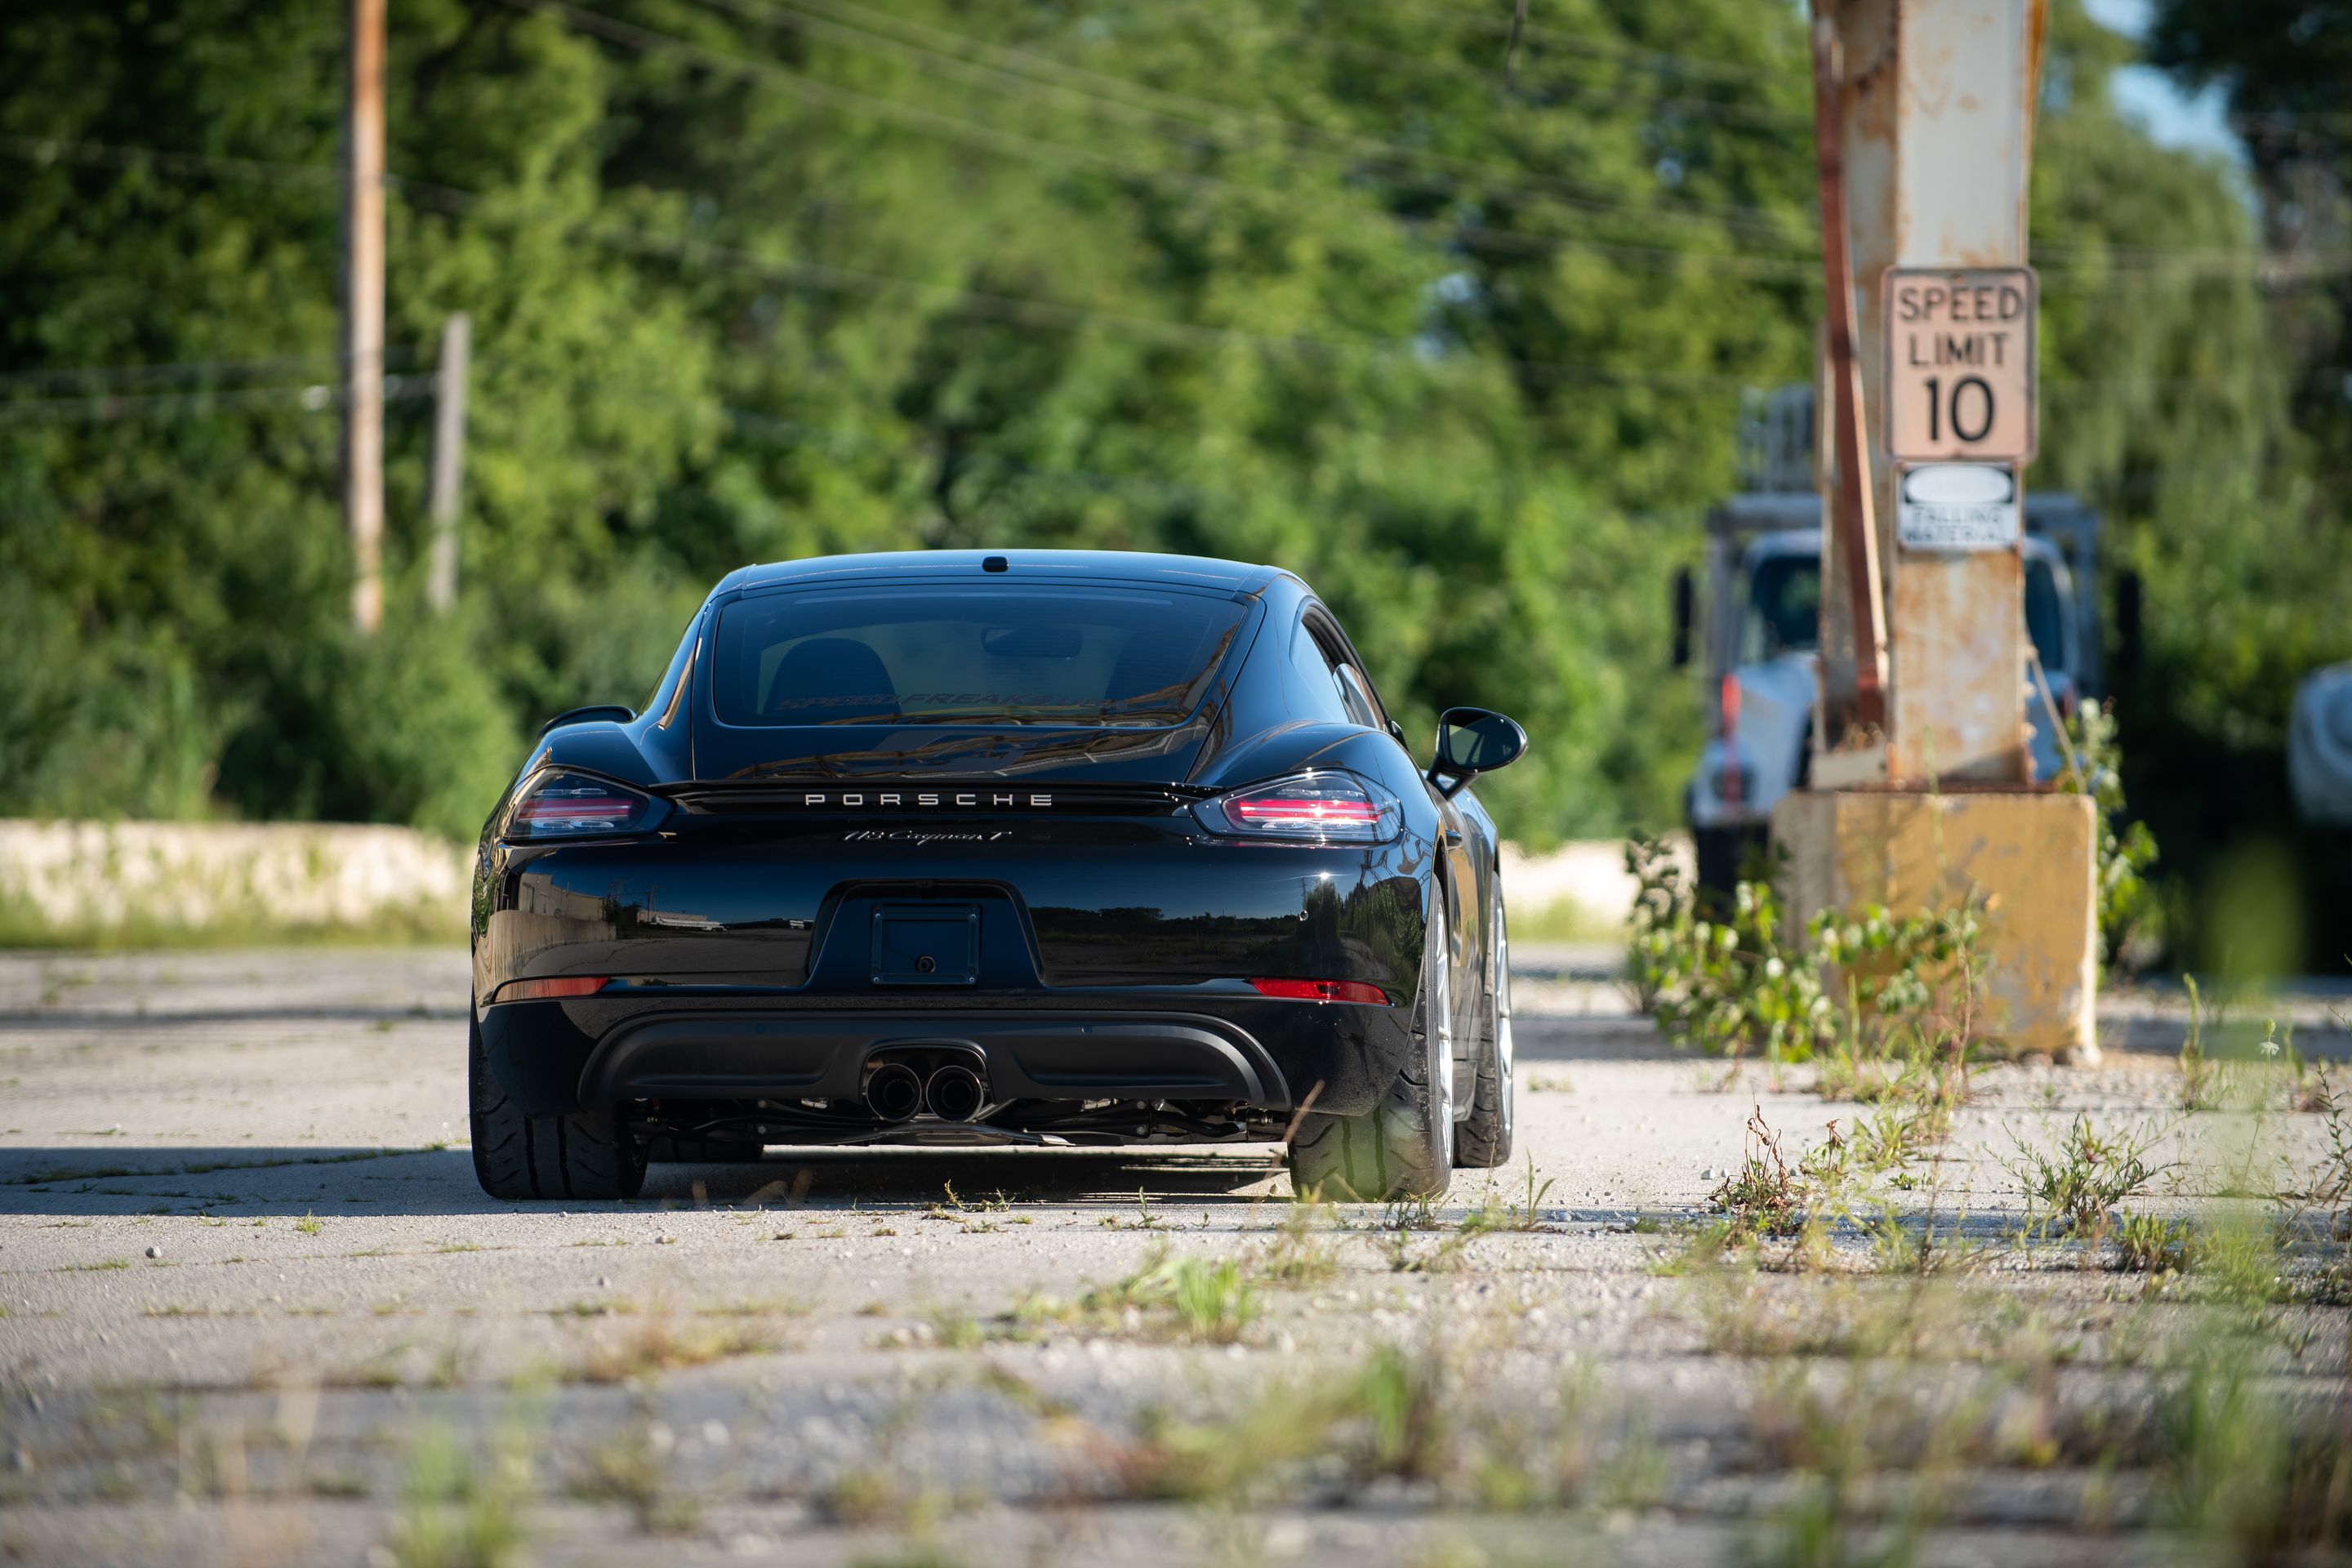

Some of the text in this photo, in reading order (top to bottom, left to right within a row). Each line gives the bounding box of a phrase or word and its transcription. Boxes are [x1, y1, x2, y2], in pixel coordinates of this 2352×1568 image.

[1900, 287, 2023, 321] SPEED
[1909, 332, 2009, 367] LIMIT
[1923, 374, 1994, 443] 10
[1912, 506, 2003, 523] FALLING
[805, 794, 1052, 806] PORSCHE
[843, 830, 1013, 846] 718 Cayman T
